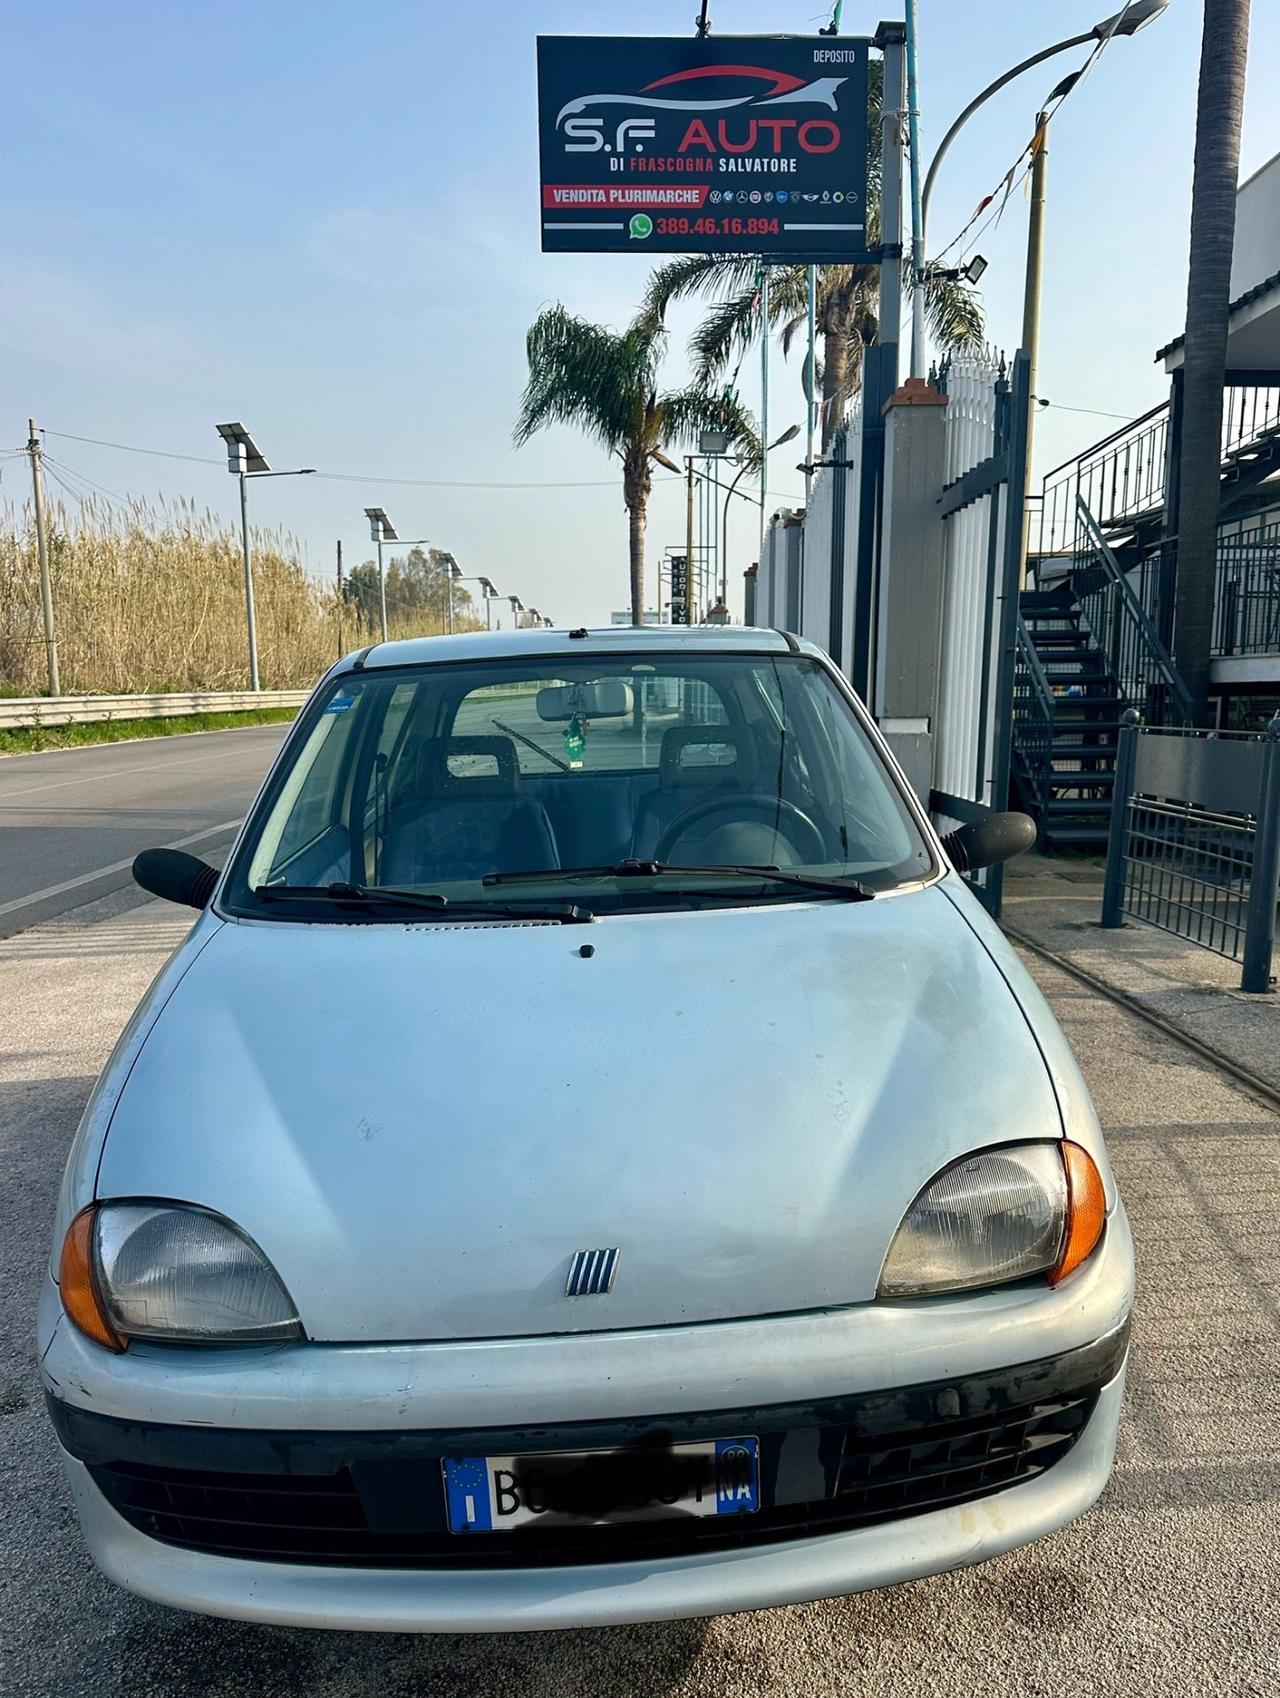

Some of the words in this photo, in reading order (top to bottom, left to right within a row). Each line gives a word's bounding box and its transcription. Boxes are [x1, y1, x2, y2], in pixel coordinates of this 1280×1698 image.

[813, 50, 855, 64] DEPOSITO
[564, 118, 656, 152] S.F.
[677, 119, 841, 153] AUTO
[609, 158, 624, 172] DI
[630, 158, 713, 172] FRASCOGNA
[719, 158, 797, 172] SALVATORE
[553, 189, 606, 203] VENDITA
[609, 189, 700, 203] PLURIMARCHE
[656, 217, 780, 235] 389.46.16.894
